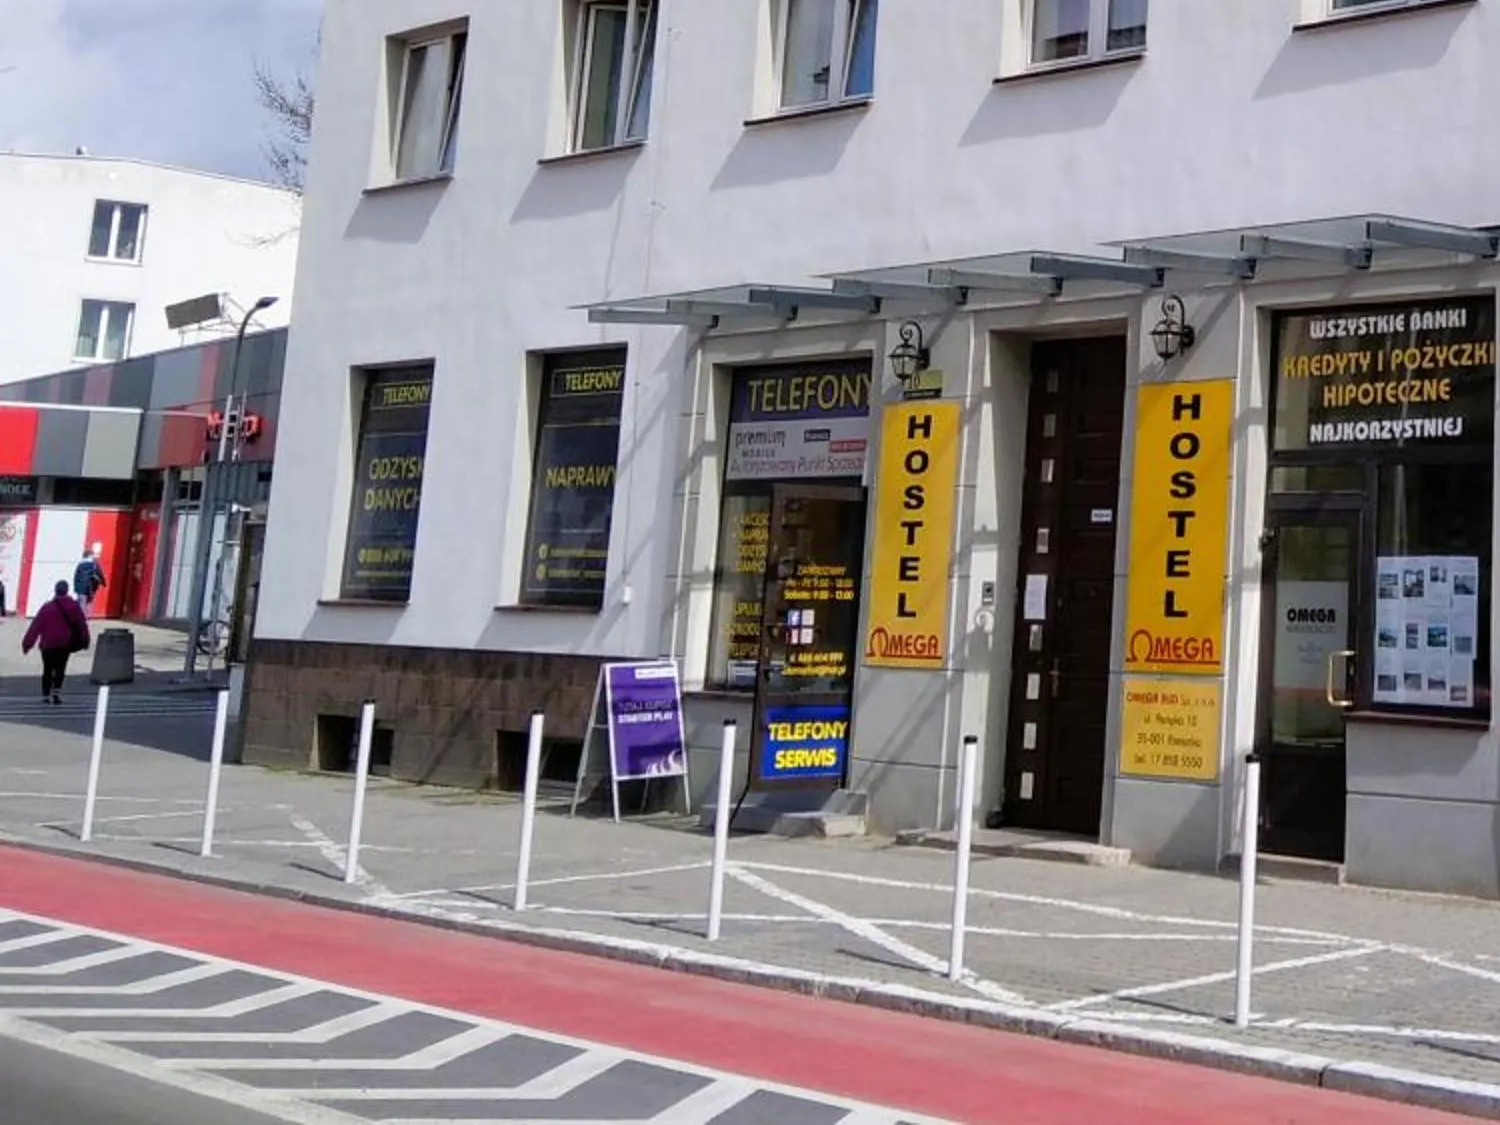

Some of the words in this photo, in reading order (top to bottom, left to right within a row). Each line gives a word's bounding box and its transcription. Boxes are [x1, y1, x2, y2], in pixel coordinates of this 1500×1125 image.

[1310, 314, 1405, 339] WSZYSTKIE
[1410, 308, 1467, 332] BANKI
[1283, 351, 1371, 378] KREDYTY
[1377, 349, 1384, 372] I
[1390, 339, 1495, 372] POŻYCZKI
[565, 369, 622, 392] TELEFONY
[748, 372, 872, 412] TELEFONY
[1323, 378, 1451, 407] HIPOTECZNE
[1310, 417, 1464, 444] NAJKORZYSTNIEJ
[896, 414, 933, 618] HOSTEL
[1163, 393, 1202, 619] HOSTEL
[1287, 608, 1337, 623] OMEGA
[767, 721, 848, 742] TELEFONY
[774, 748, 837, 770] SERWIS
